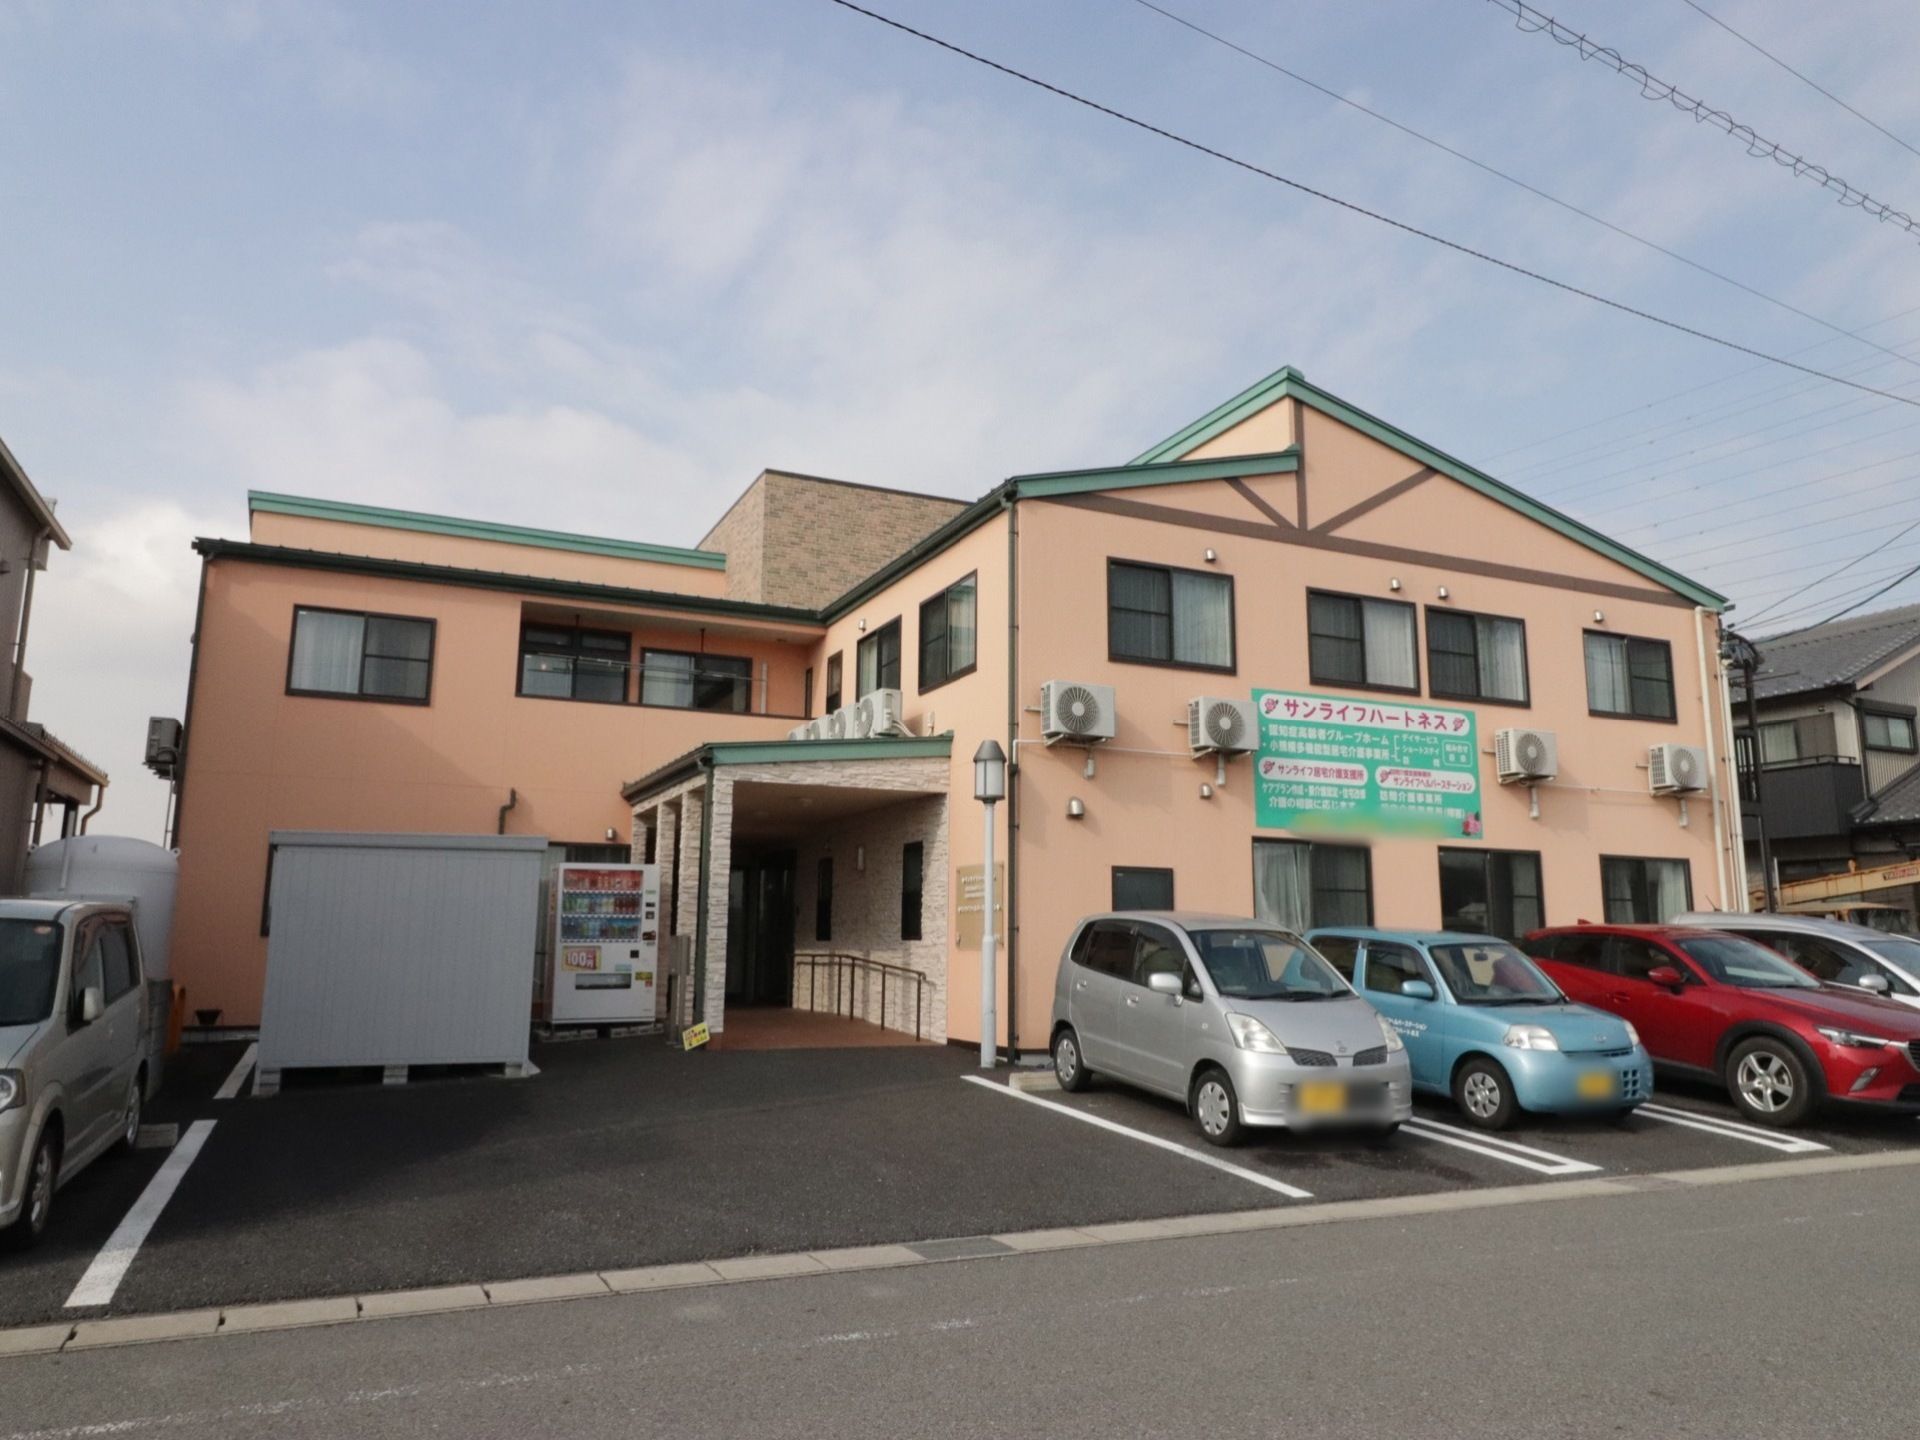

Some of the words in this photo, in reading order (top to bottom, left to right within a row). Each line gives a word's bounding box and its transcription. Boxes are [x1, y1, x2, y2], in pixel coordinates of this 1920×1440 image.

[1284, 699, 1447, 730] サンライフハートネス
